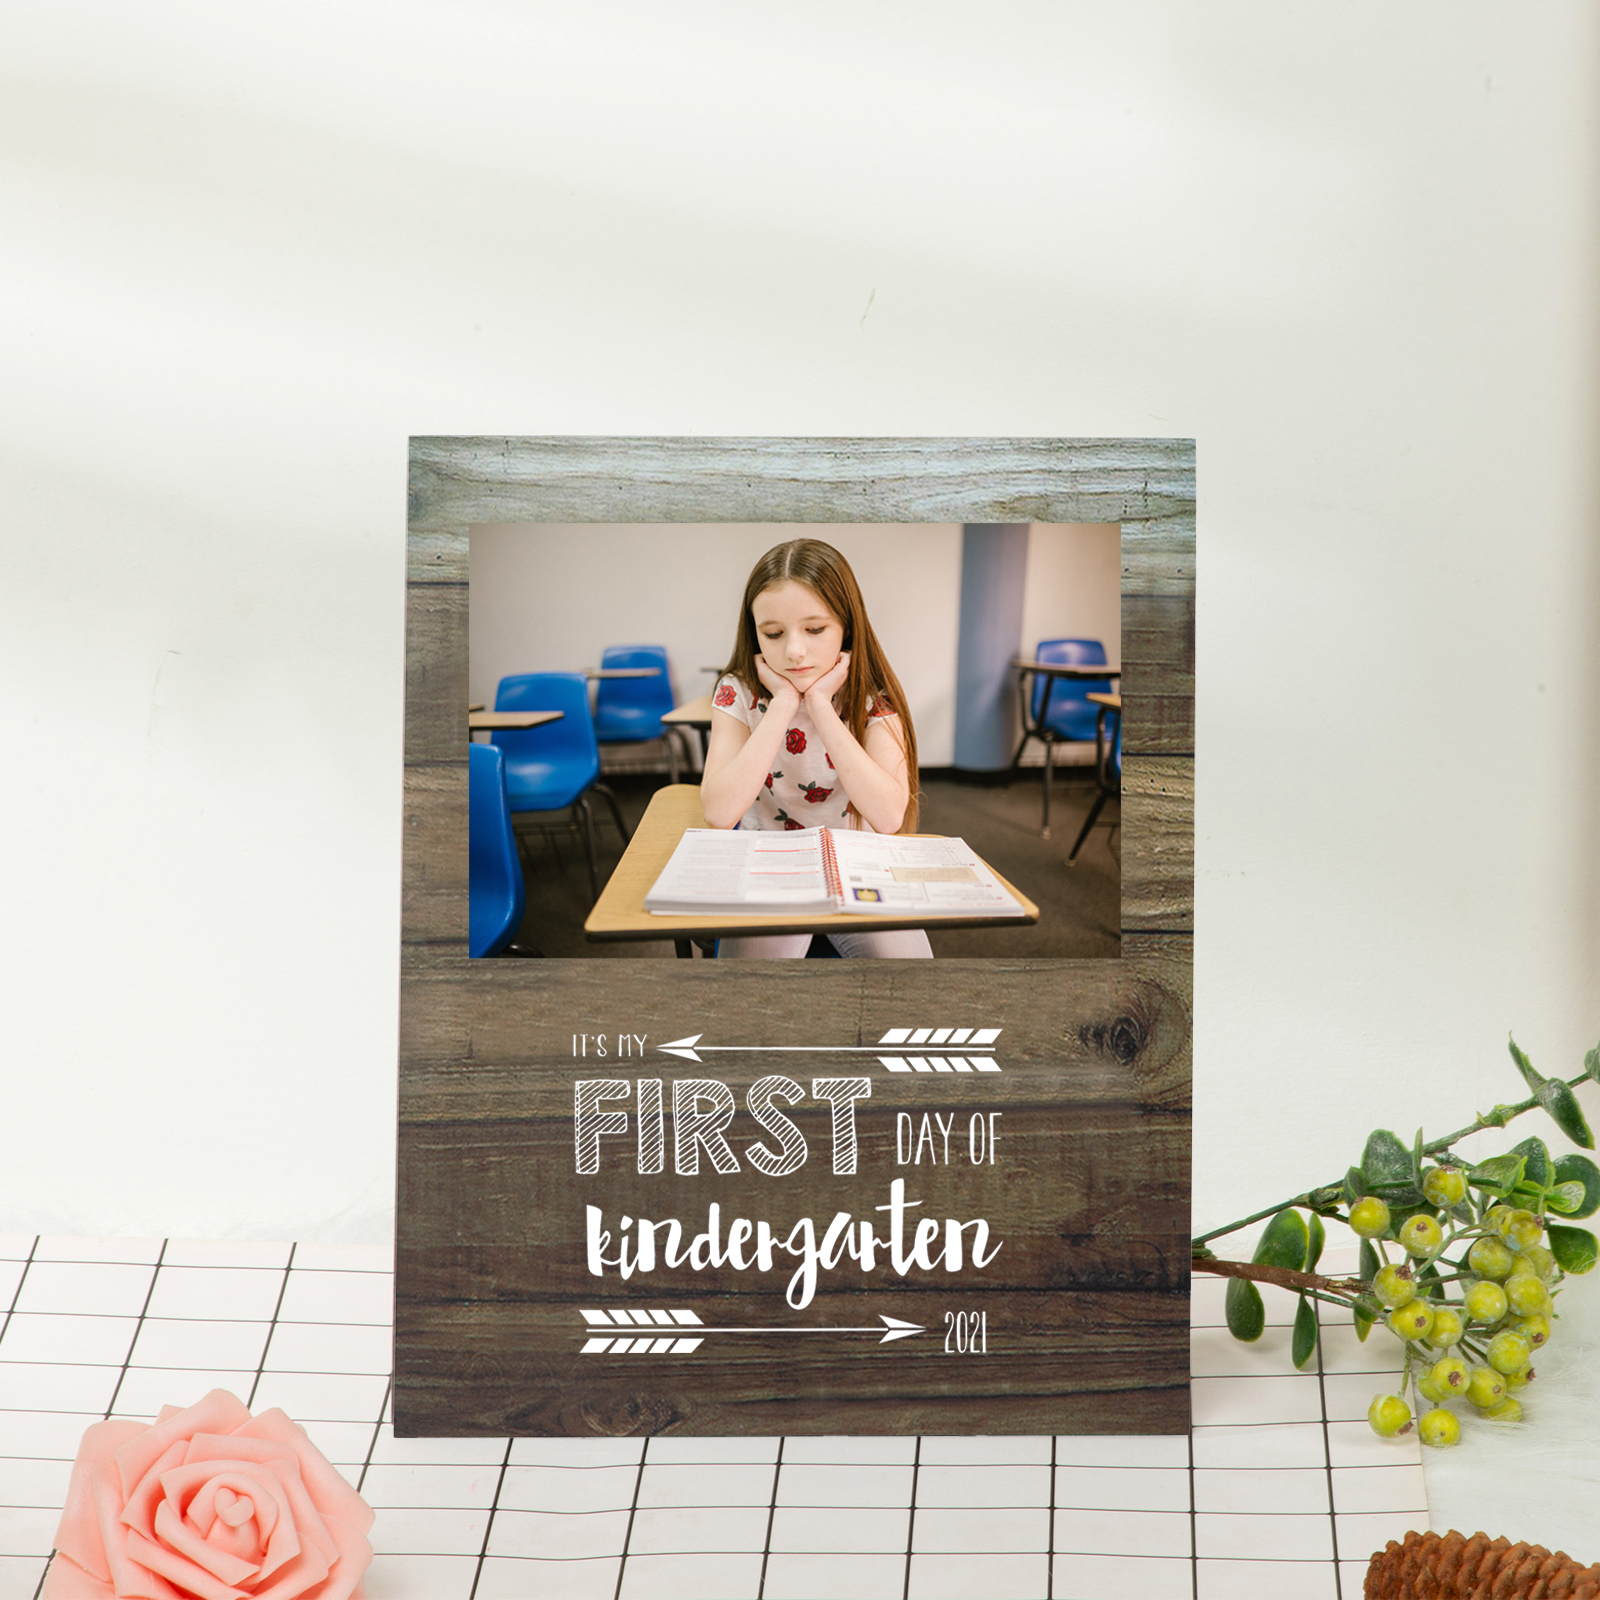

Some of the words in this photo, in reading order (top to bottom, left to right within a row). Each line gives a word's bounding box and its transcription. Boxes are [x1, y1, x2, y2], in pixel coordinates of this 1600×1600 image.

[573, 1034, 608, 1057] IT'S
[618, 1034, 648, 1057] MY
[574, 1075, 872, 1176] FIRST
[897, 1112, 955, 1165] DAY
[969, 1112, 1003, 1165] OF
[586, 1178, 1003, 1310] kindergarten
[945, 1311, 987, 1353] 2021
